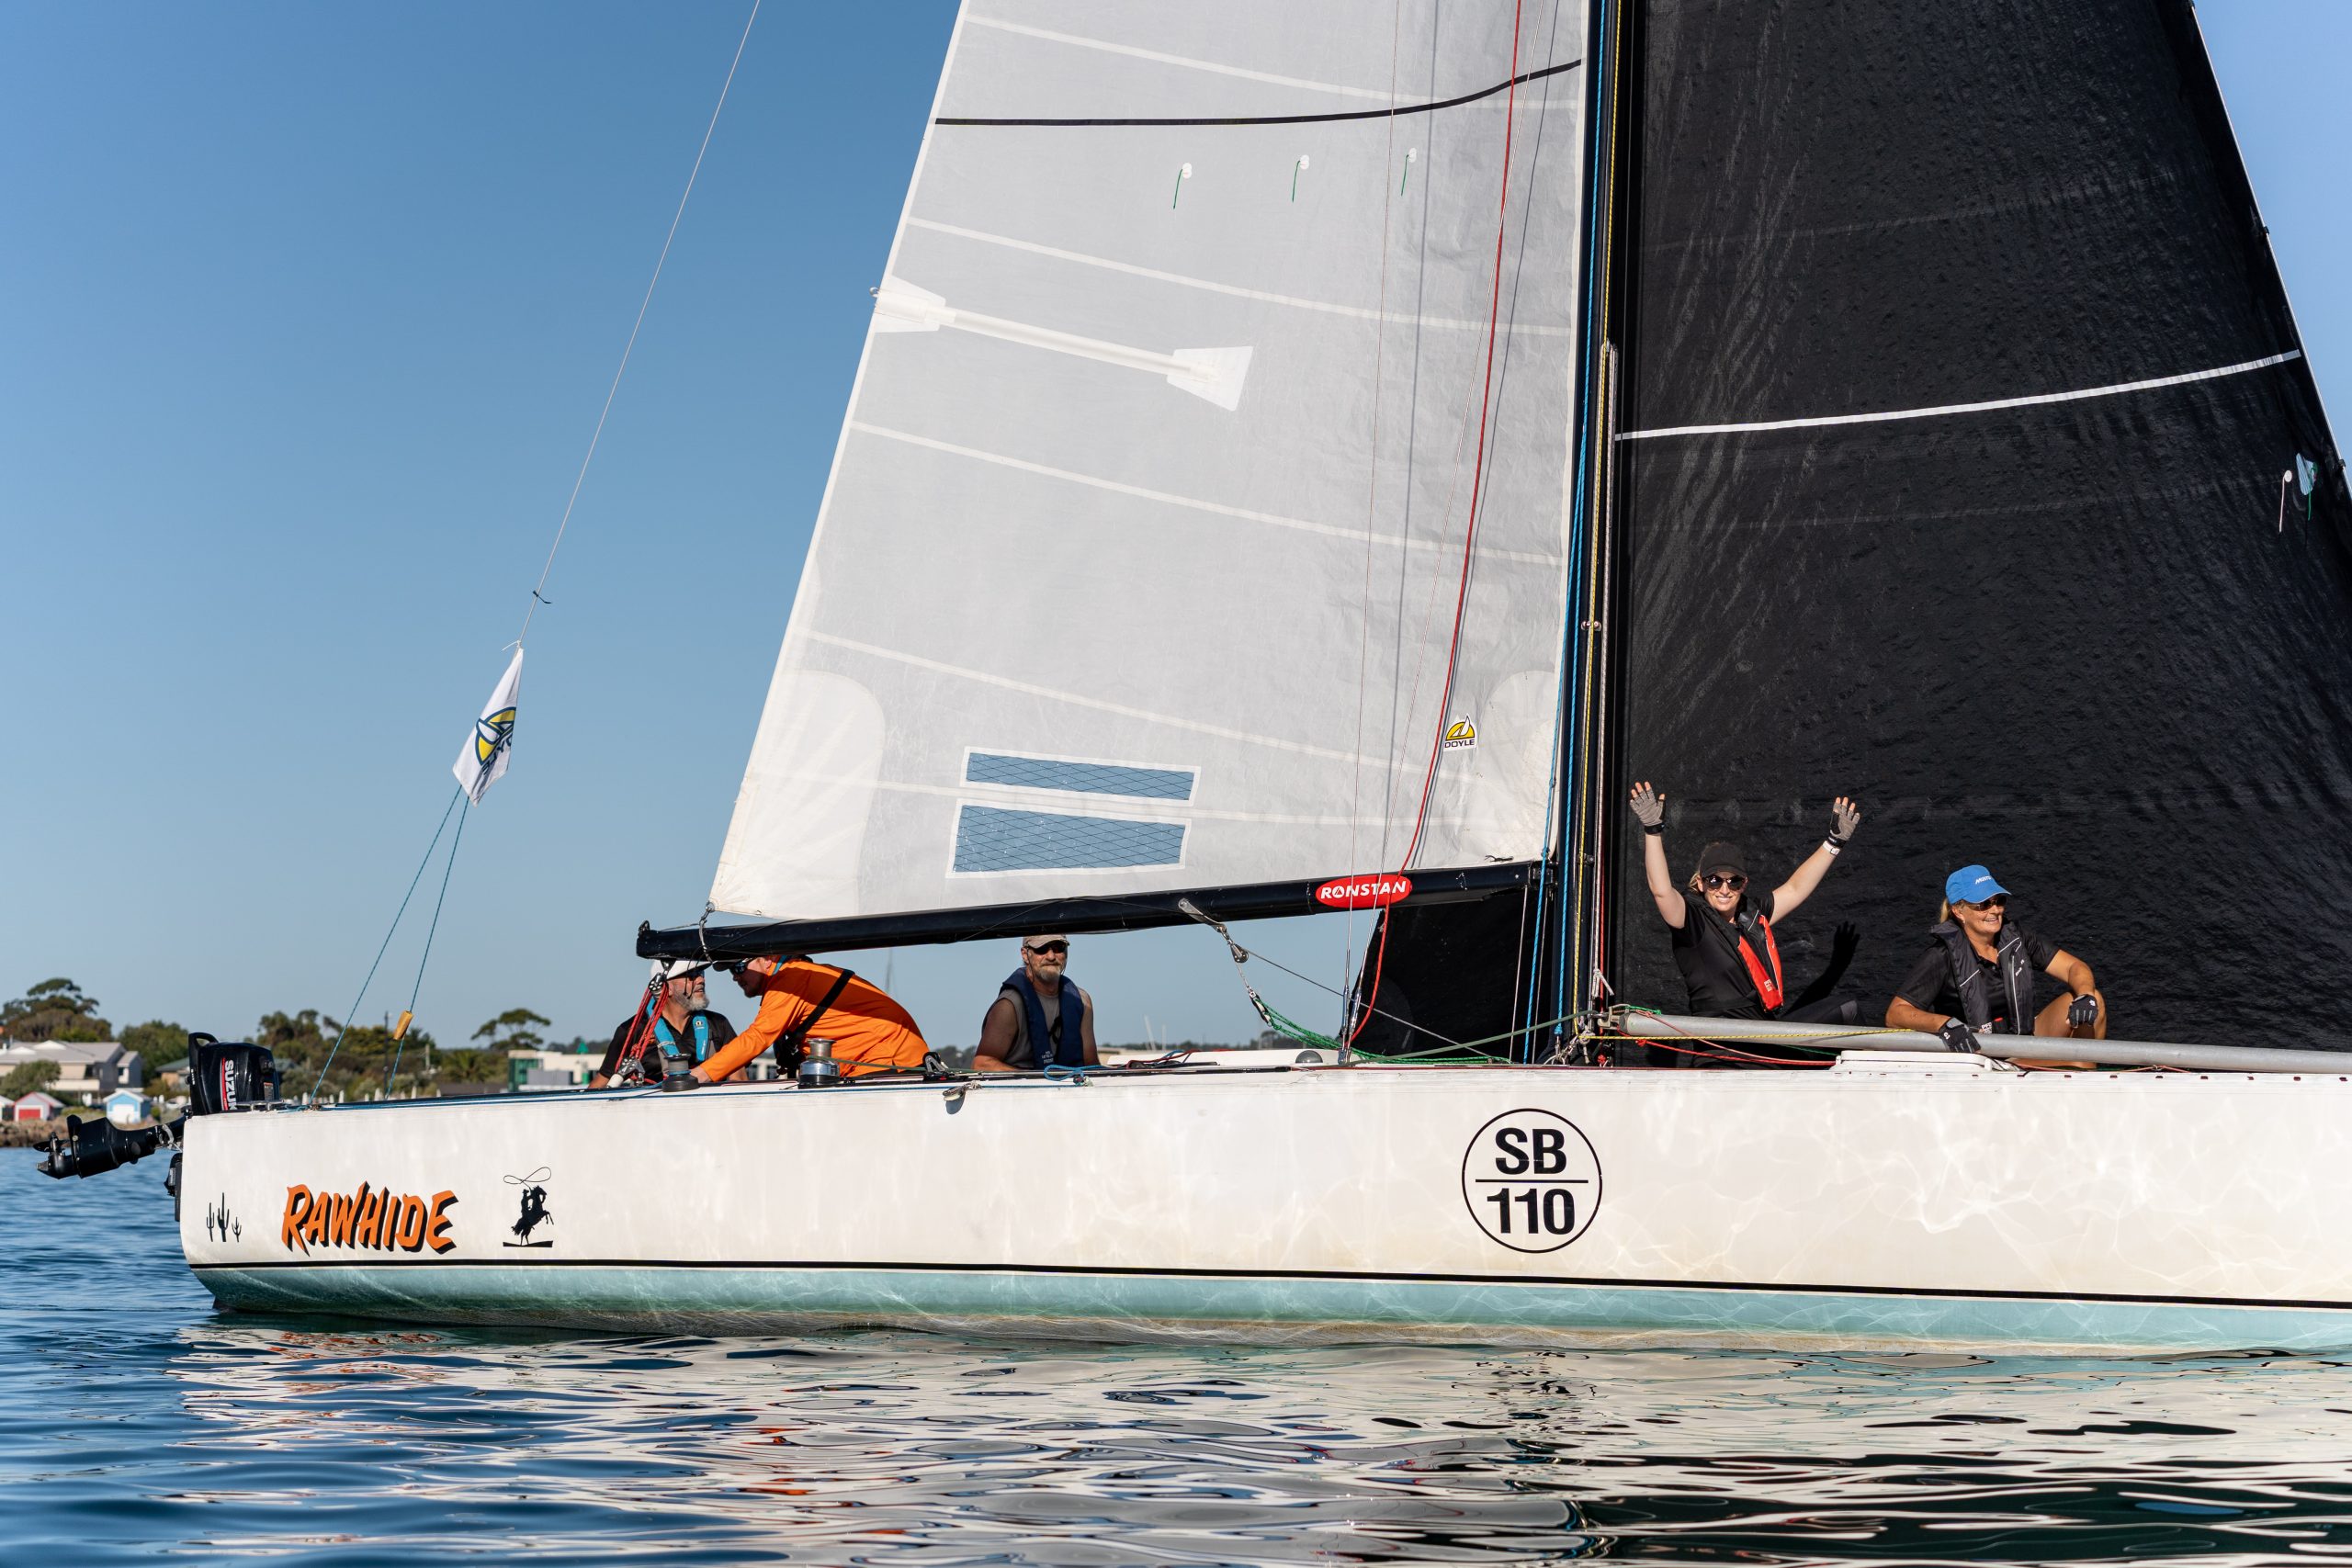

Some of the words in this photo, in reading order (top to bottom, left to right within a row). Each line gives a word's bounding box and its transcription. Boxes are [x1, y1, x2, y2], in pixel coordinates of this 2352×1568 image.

[1444, 739, 1475, 748] DOYLE
[1320, 881, 1407, 899] RONSTAN
[225, 1059, 238, 1111] SUZUK
[1495, 1127, 1567, 1175] SB
[281, 1180, 459, 1258] RAWHIDE
[1487, 1188, 1576, 1235] 110
